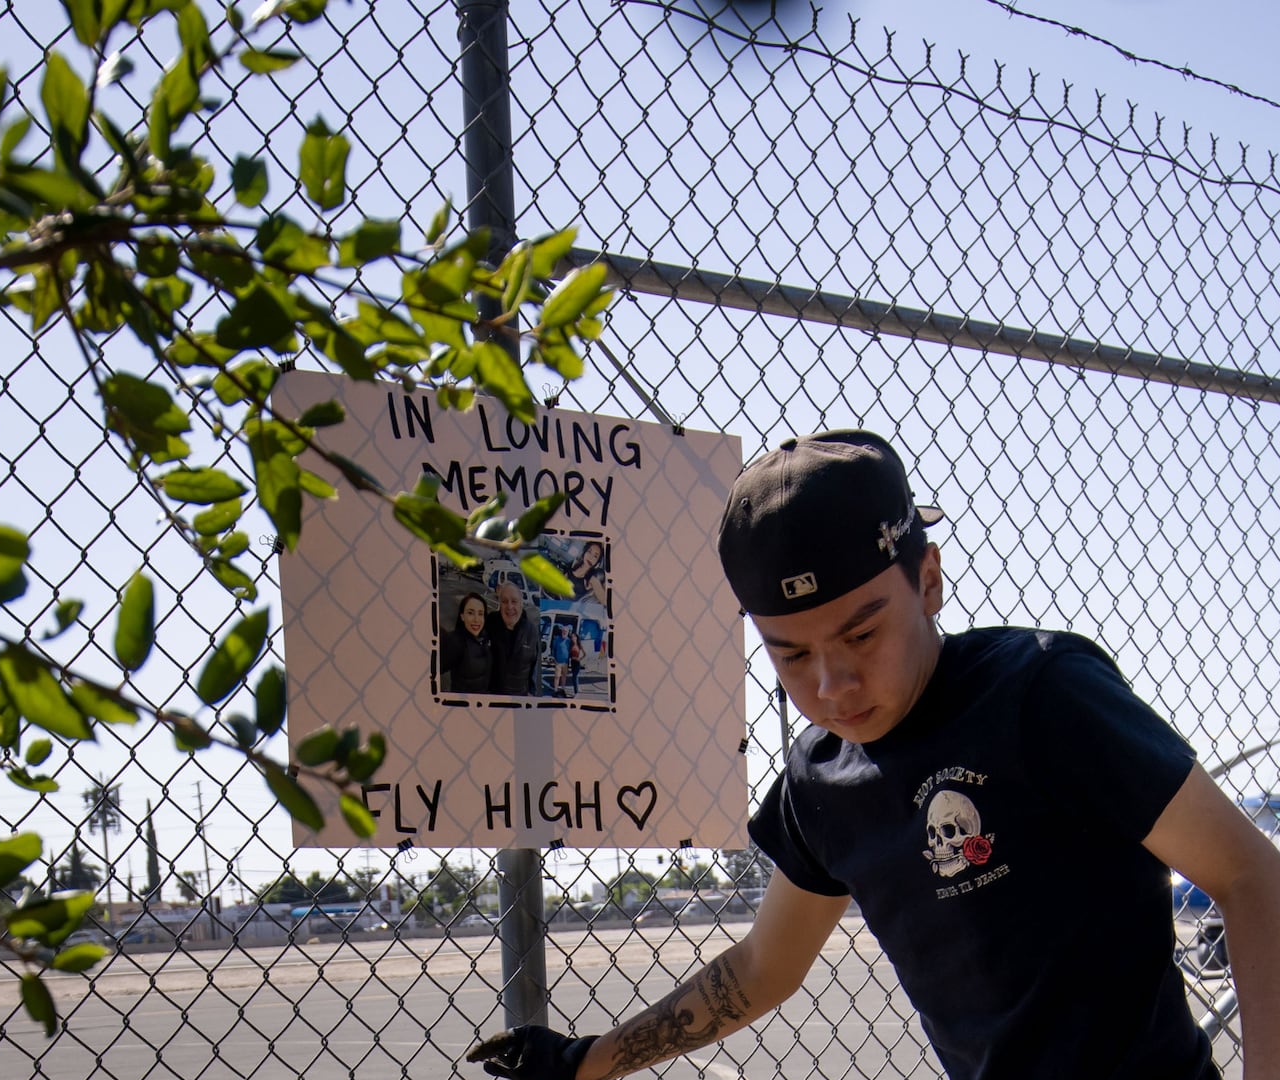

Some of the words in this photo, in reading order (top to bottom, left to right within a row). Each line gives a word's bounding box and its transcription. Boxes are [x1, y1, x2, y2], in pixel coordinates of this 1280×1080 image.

[387, 392, 436, 444] IN
[478, 403, 642, 469] LOVING
[422, 460, 614, 527] MEMORY
[360, 780, 442, 834] FLY
[484, 780, 604, 832] HIGH
